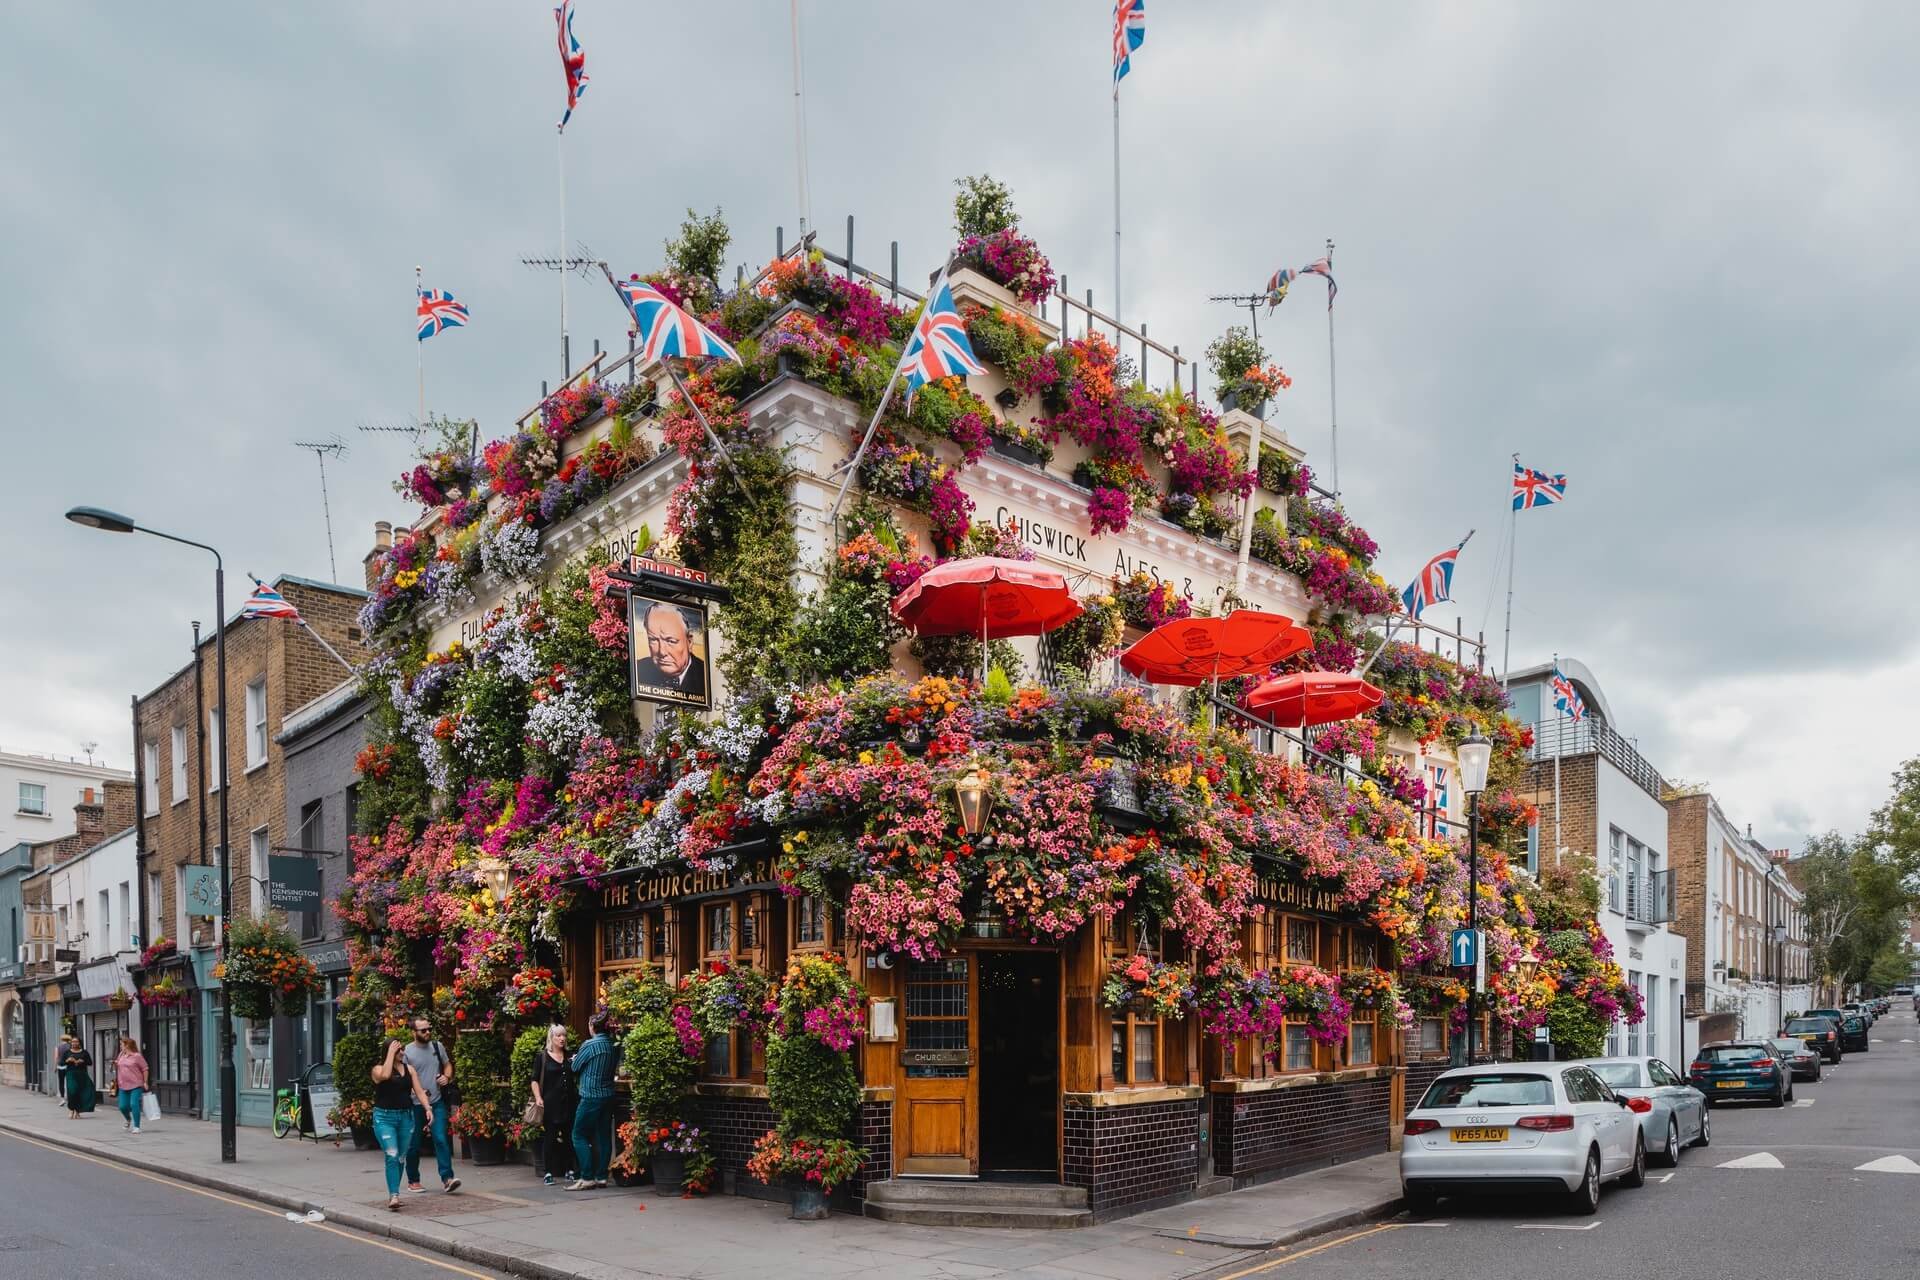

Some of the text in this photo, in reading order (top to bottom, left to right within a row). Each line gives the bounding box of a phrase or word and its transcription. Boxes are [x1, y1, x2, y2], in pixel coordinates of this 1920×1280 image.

[996, 506, 1087, 562] CHISWICK
[639, 685, 652, 694] THE
[652, 687, 688, 699] CHURCHILL
[272, 889, 319, 897] KENSINGTON
[603, 885, 629, 908] THE
[637, 868, 730, 902] CHURCHILL
[1251, 875, 1313, 908] HURCHILL
[1455, 1129, 1505, 1140] VF65 AGV
